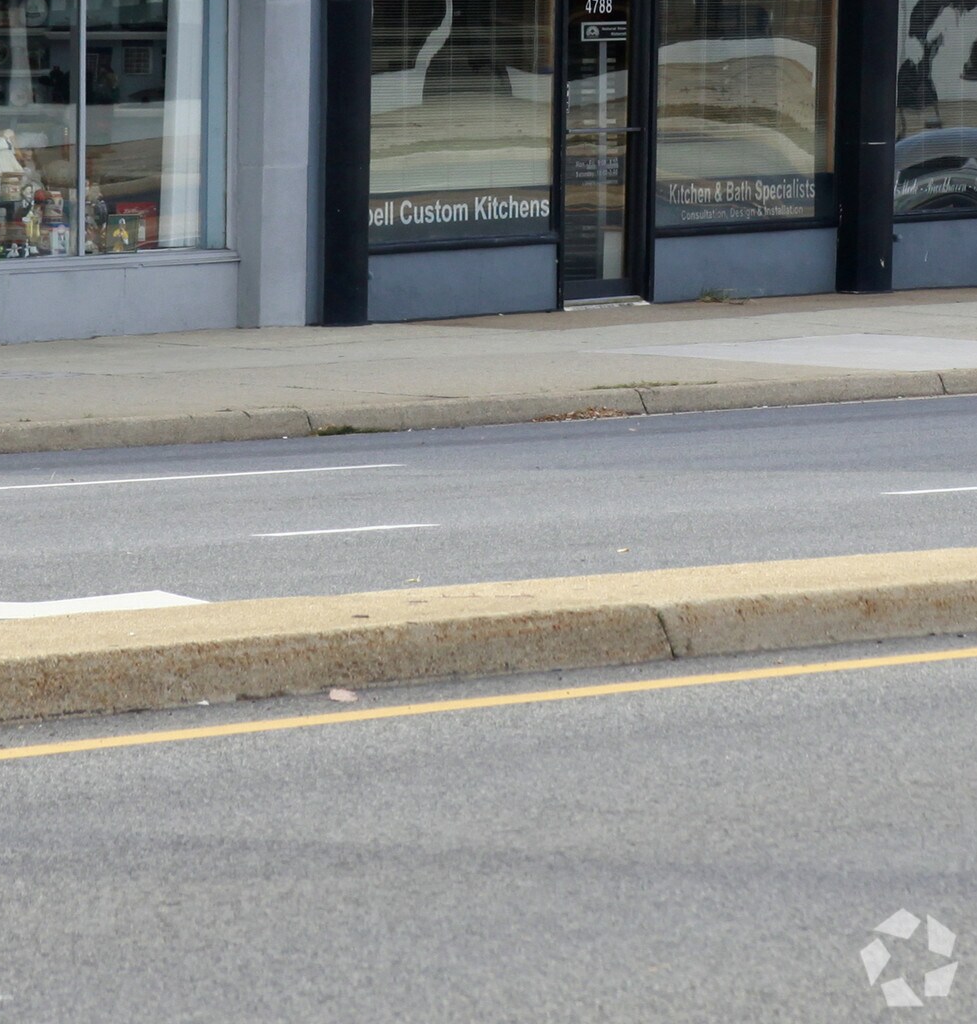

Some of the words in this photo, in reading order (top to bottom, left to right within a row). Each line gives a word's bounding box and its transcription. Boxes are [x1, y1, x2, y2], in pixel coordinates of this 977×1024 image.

[669, 183, 711, 205] Kitchen
[714, 181, 723, 202] &
[726, 180, 752, 202] Bath
[755, 178, 816, 205] Specialists
[400, 199, 469, 225] Custom
[474, 195, 550, 221] Kitchens
[730, 208, 756, 220] Design
[756, 207, 763, 217] &
[764, 205, 804, 216] Installation
